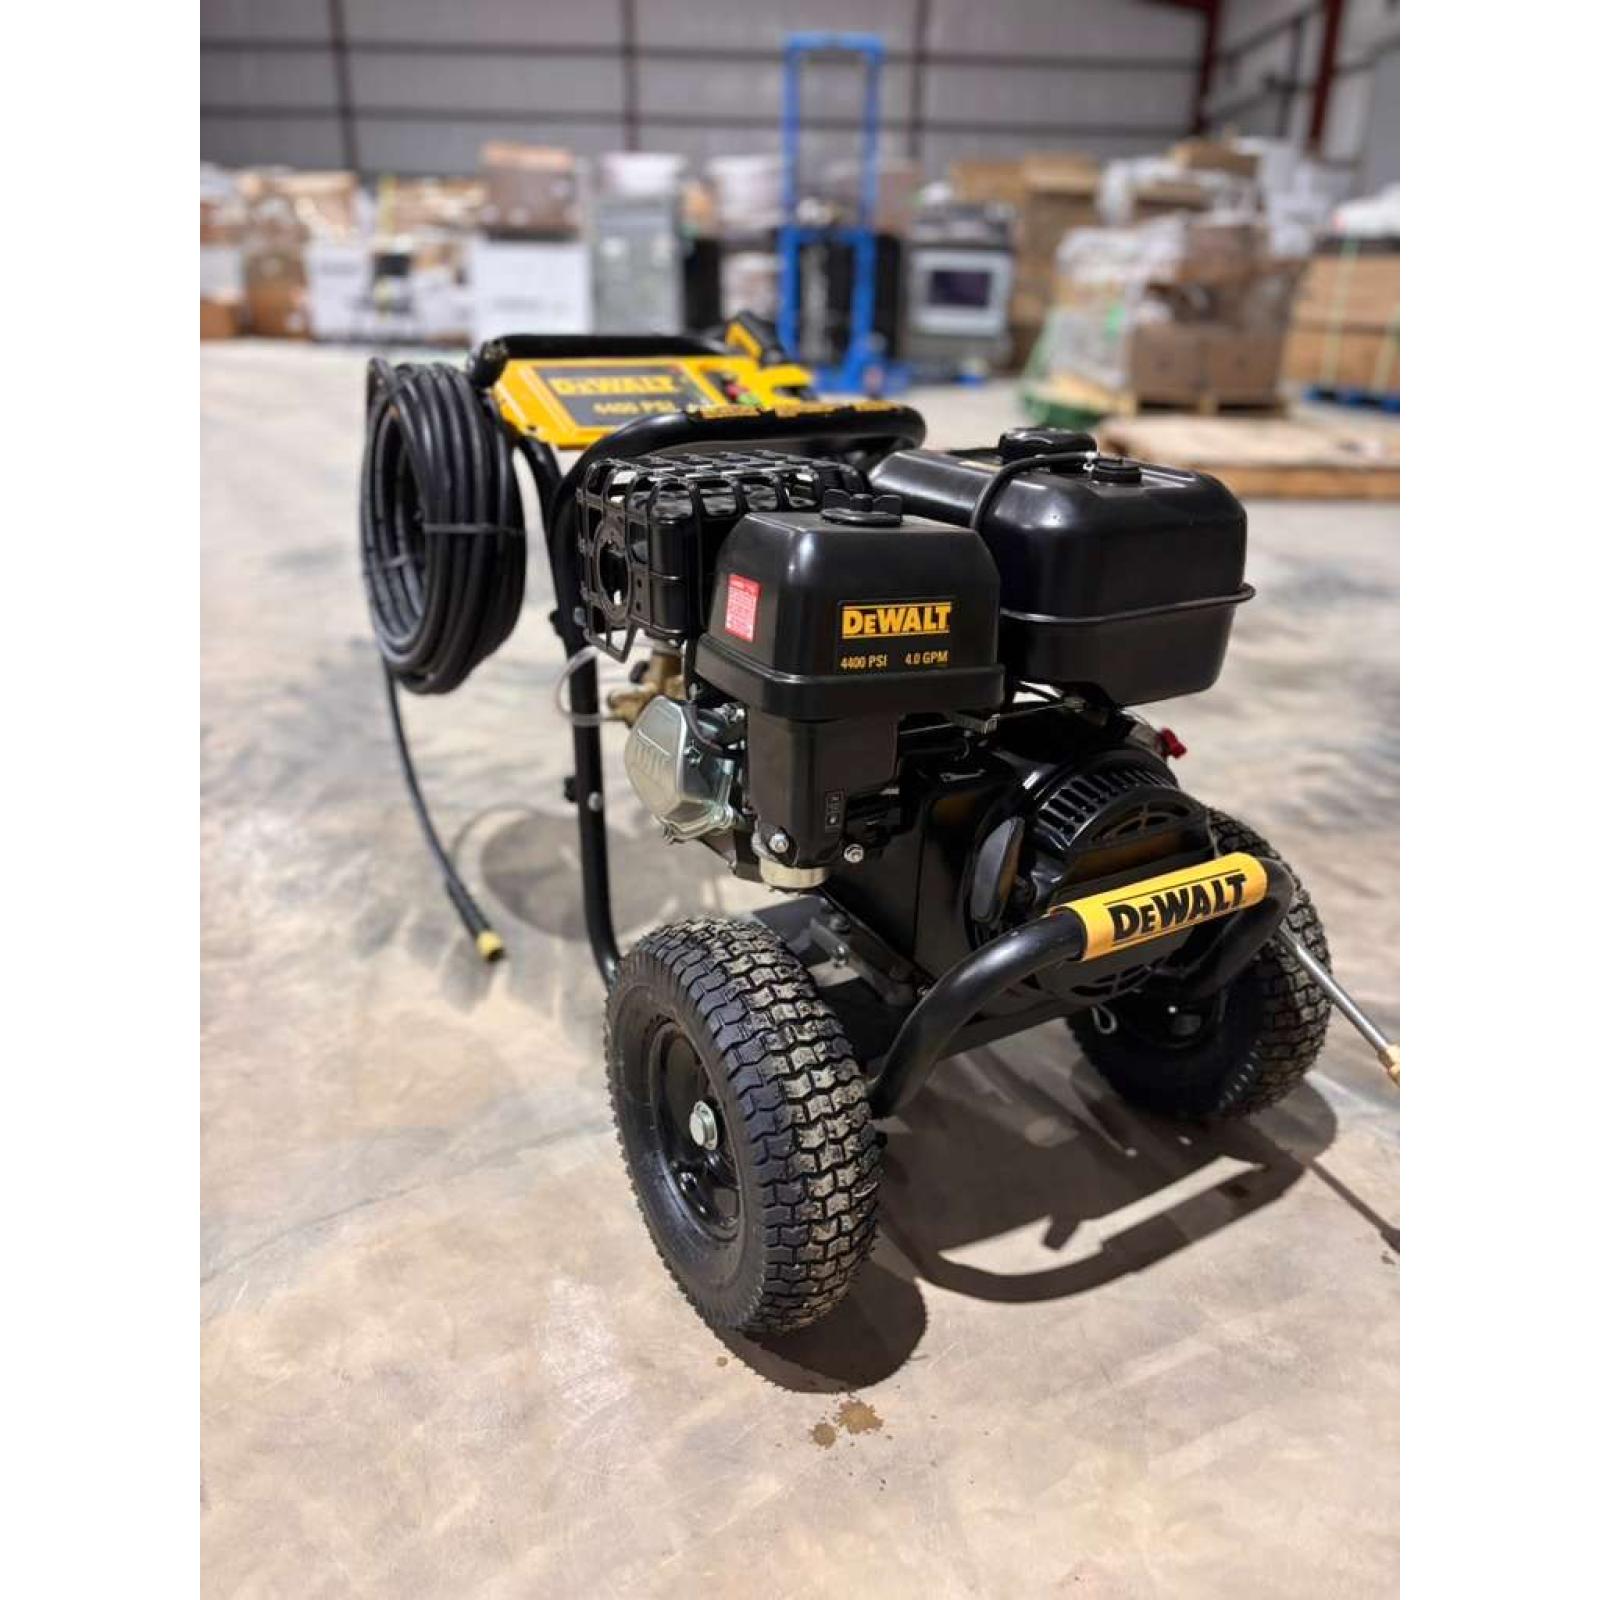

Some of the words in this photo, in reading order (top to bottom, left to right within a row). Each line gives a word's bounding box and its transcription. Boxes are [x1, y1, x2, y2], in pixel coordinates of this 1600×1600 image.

[593, 402, 636, 415] 4400
[639, 401, 676, 414] PSI
[840, 656, 866, 669] 4400
[868, 654, 888, 668] PSI
[905, 653, 921, 665] 4.0
[922, 650, 948, 665] GPM
